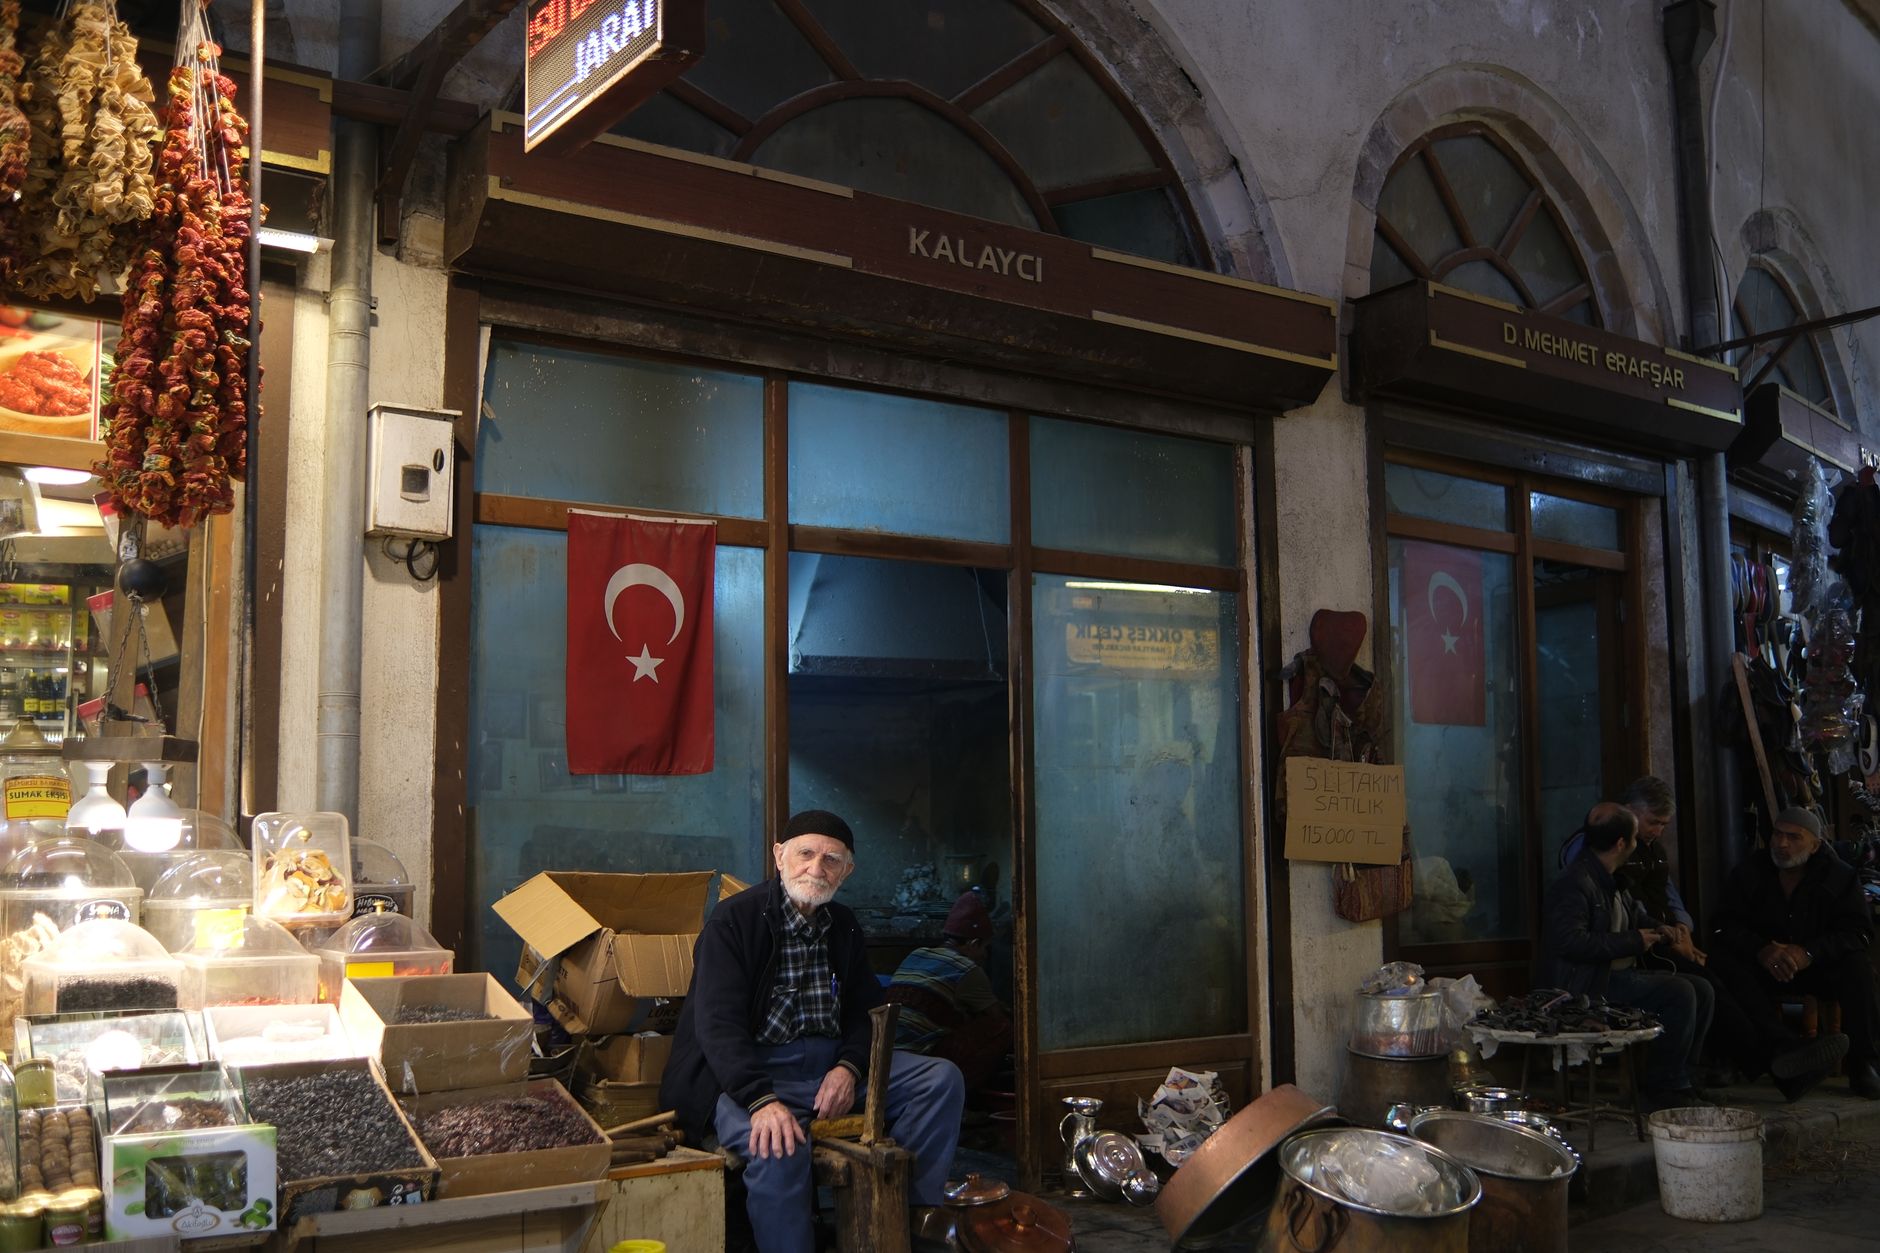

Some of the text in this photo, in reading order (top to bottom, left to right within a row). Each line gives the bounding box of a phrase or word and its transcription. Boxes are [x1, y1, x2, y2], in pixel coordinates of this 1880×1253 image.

[909, 227, 1042, 282] KALAYCI
[1343, 771, 1400, 793] TAKIM
[9, 791, 42, 799] SUMAK
[1314, 795, 1384, 814] SATILIK
[1361, 830, 1386, 845] TL
